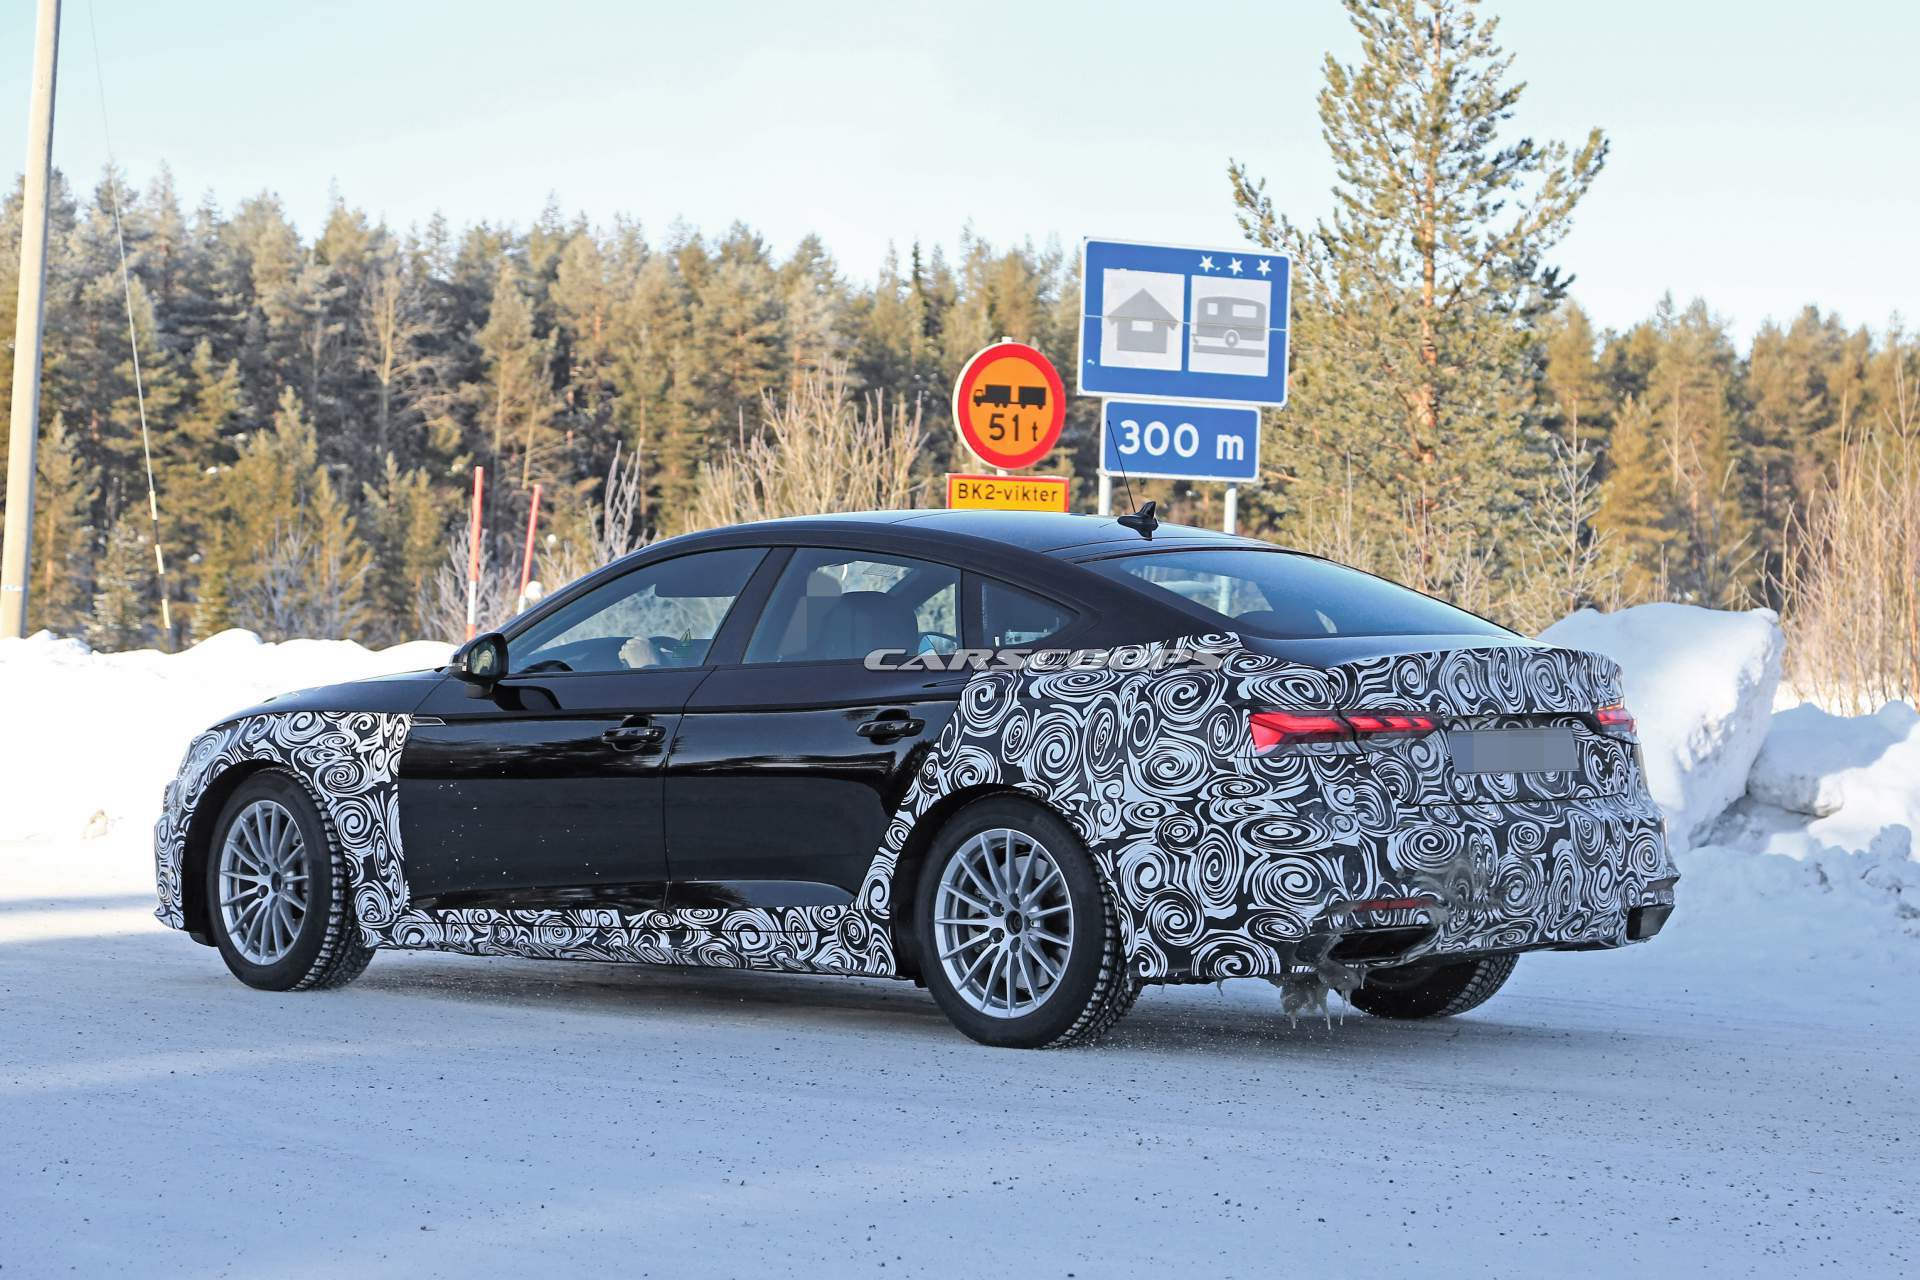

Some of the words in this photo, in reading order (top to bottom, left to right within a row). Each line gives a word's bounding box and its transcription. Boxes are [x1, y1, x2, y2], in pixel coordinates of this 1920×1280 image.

[989, 413, 1020, 442] 51
[1031, 421, 1039, 442] t
[1118, 420, 1200, 458] 300
[1216, 433, 1244, 461] m
[957, 483, 1059, 503] BK2-vikter
